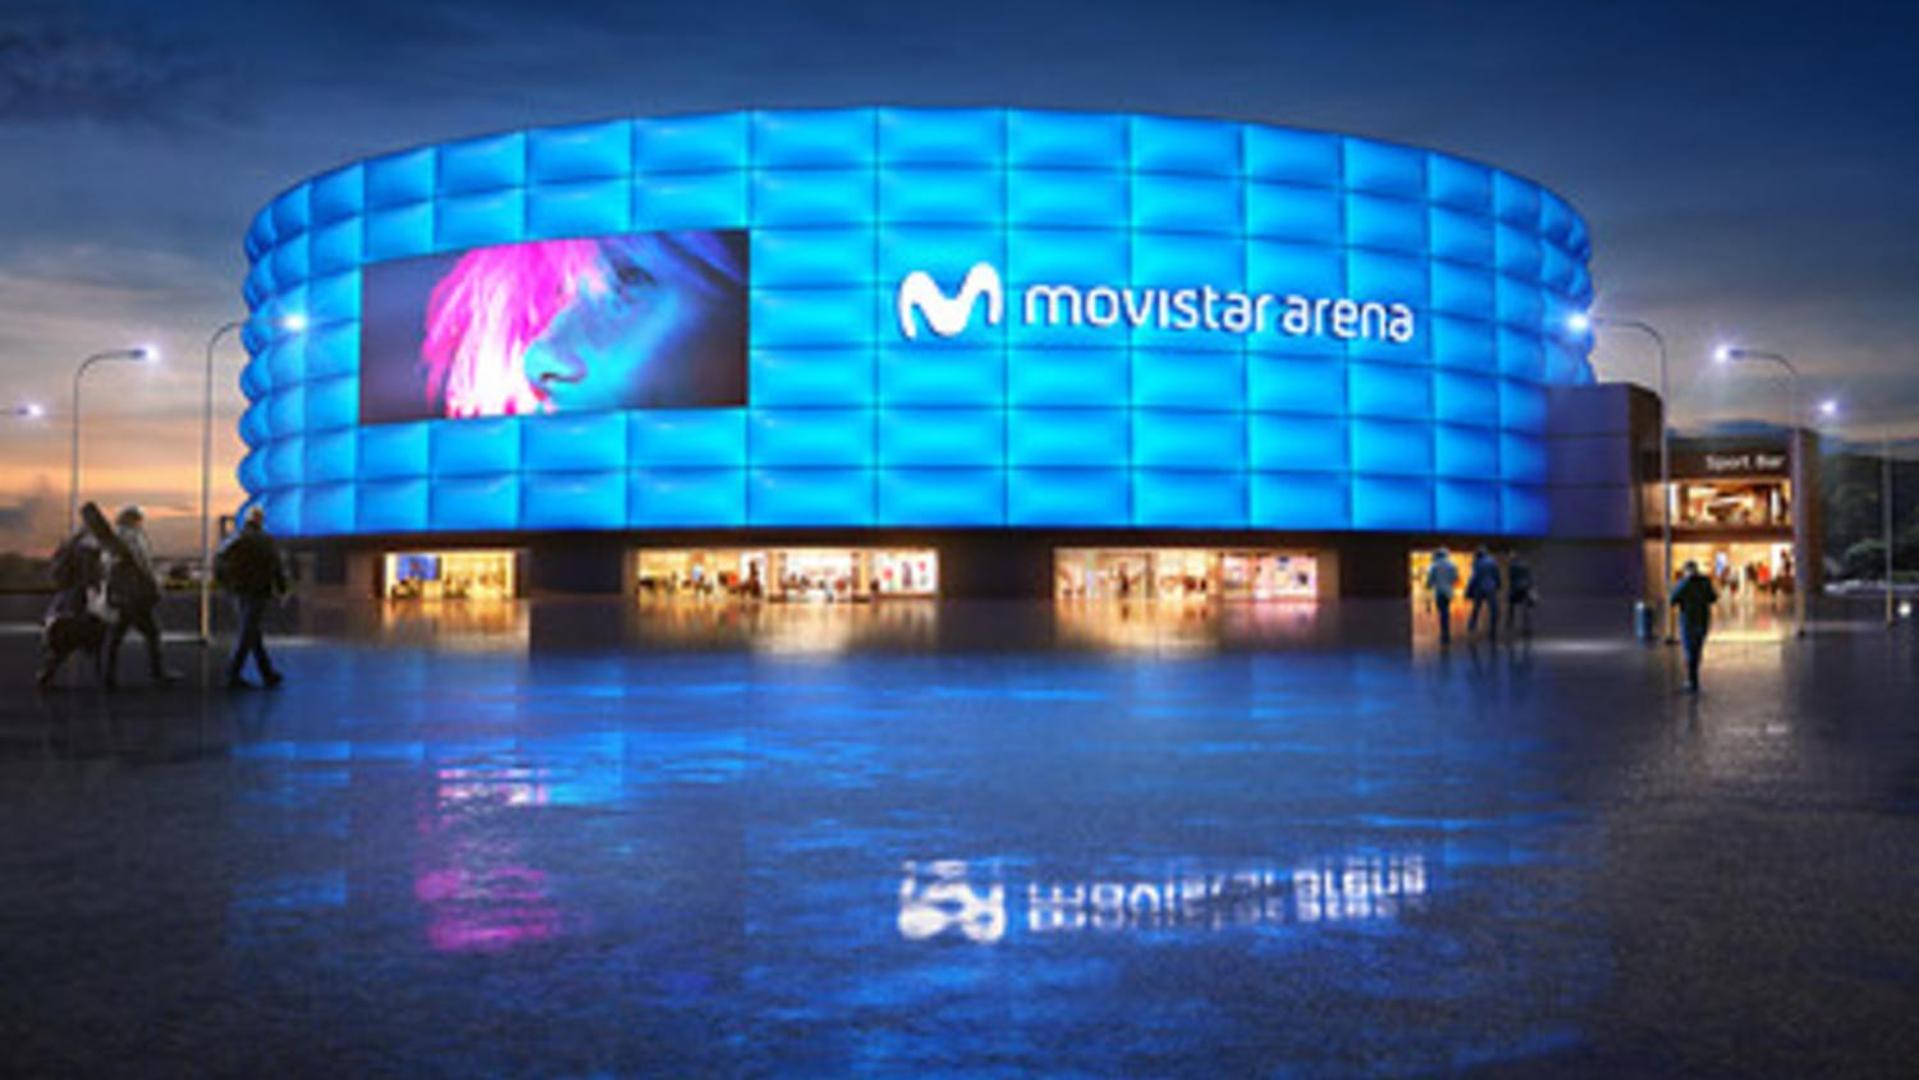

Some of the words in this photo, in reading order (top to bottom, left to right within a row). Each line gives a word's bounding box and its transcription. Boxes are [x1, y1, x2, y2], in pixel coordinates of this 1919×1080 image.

[1024, 284, 1271, 333] movistar
[1282, 297, 1414, 342] arena
[1705, 455, 1749, 472] Sport
[1756, 454, 1785, 468] Bar
